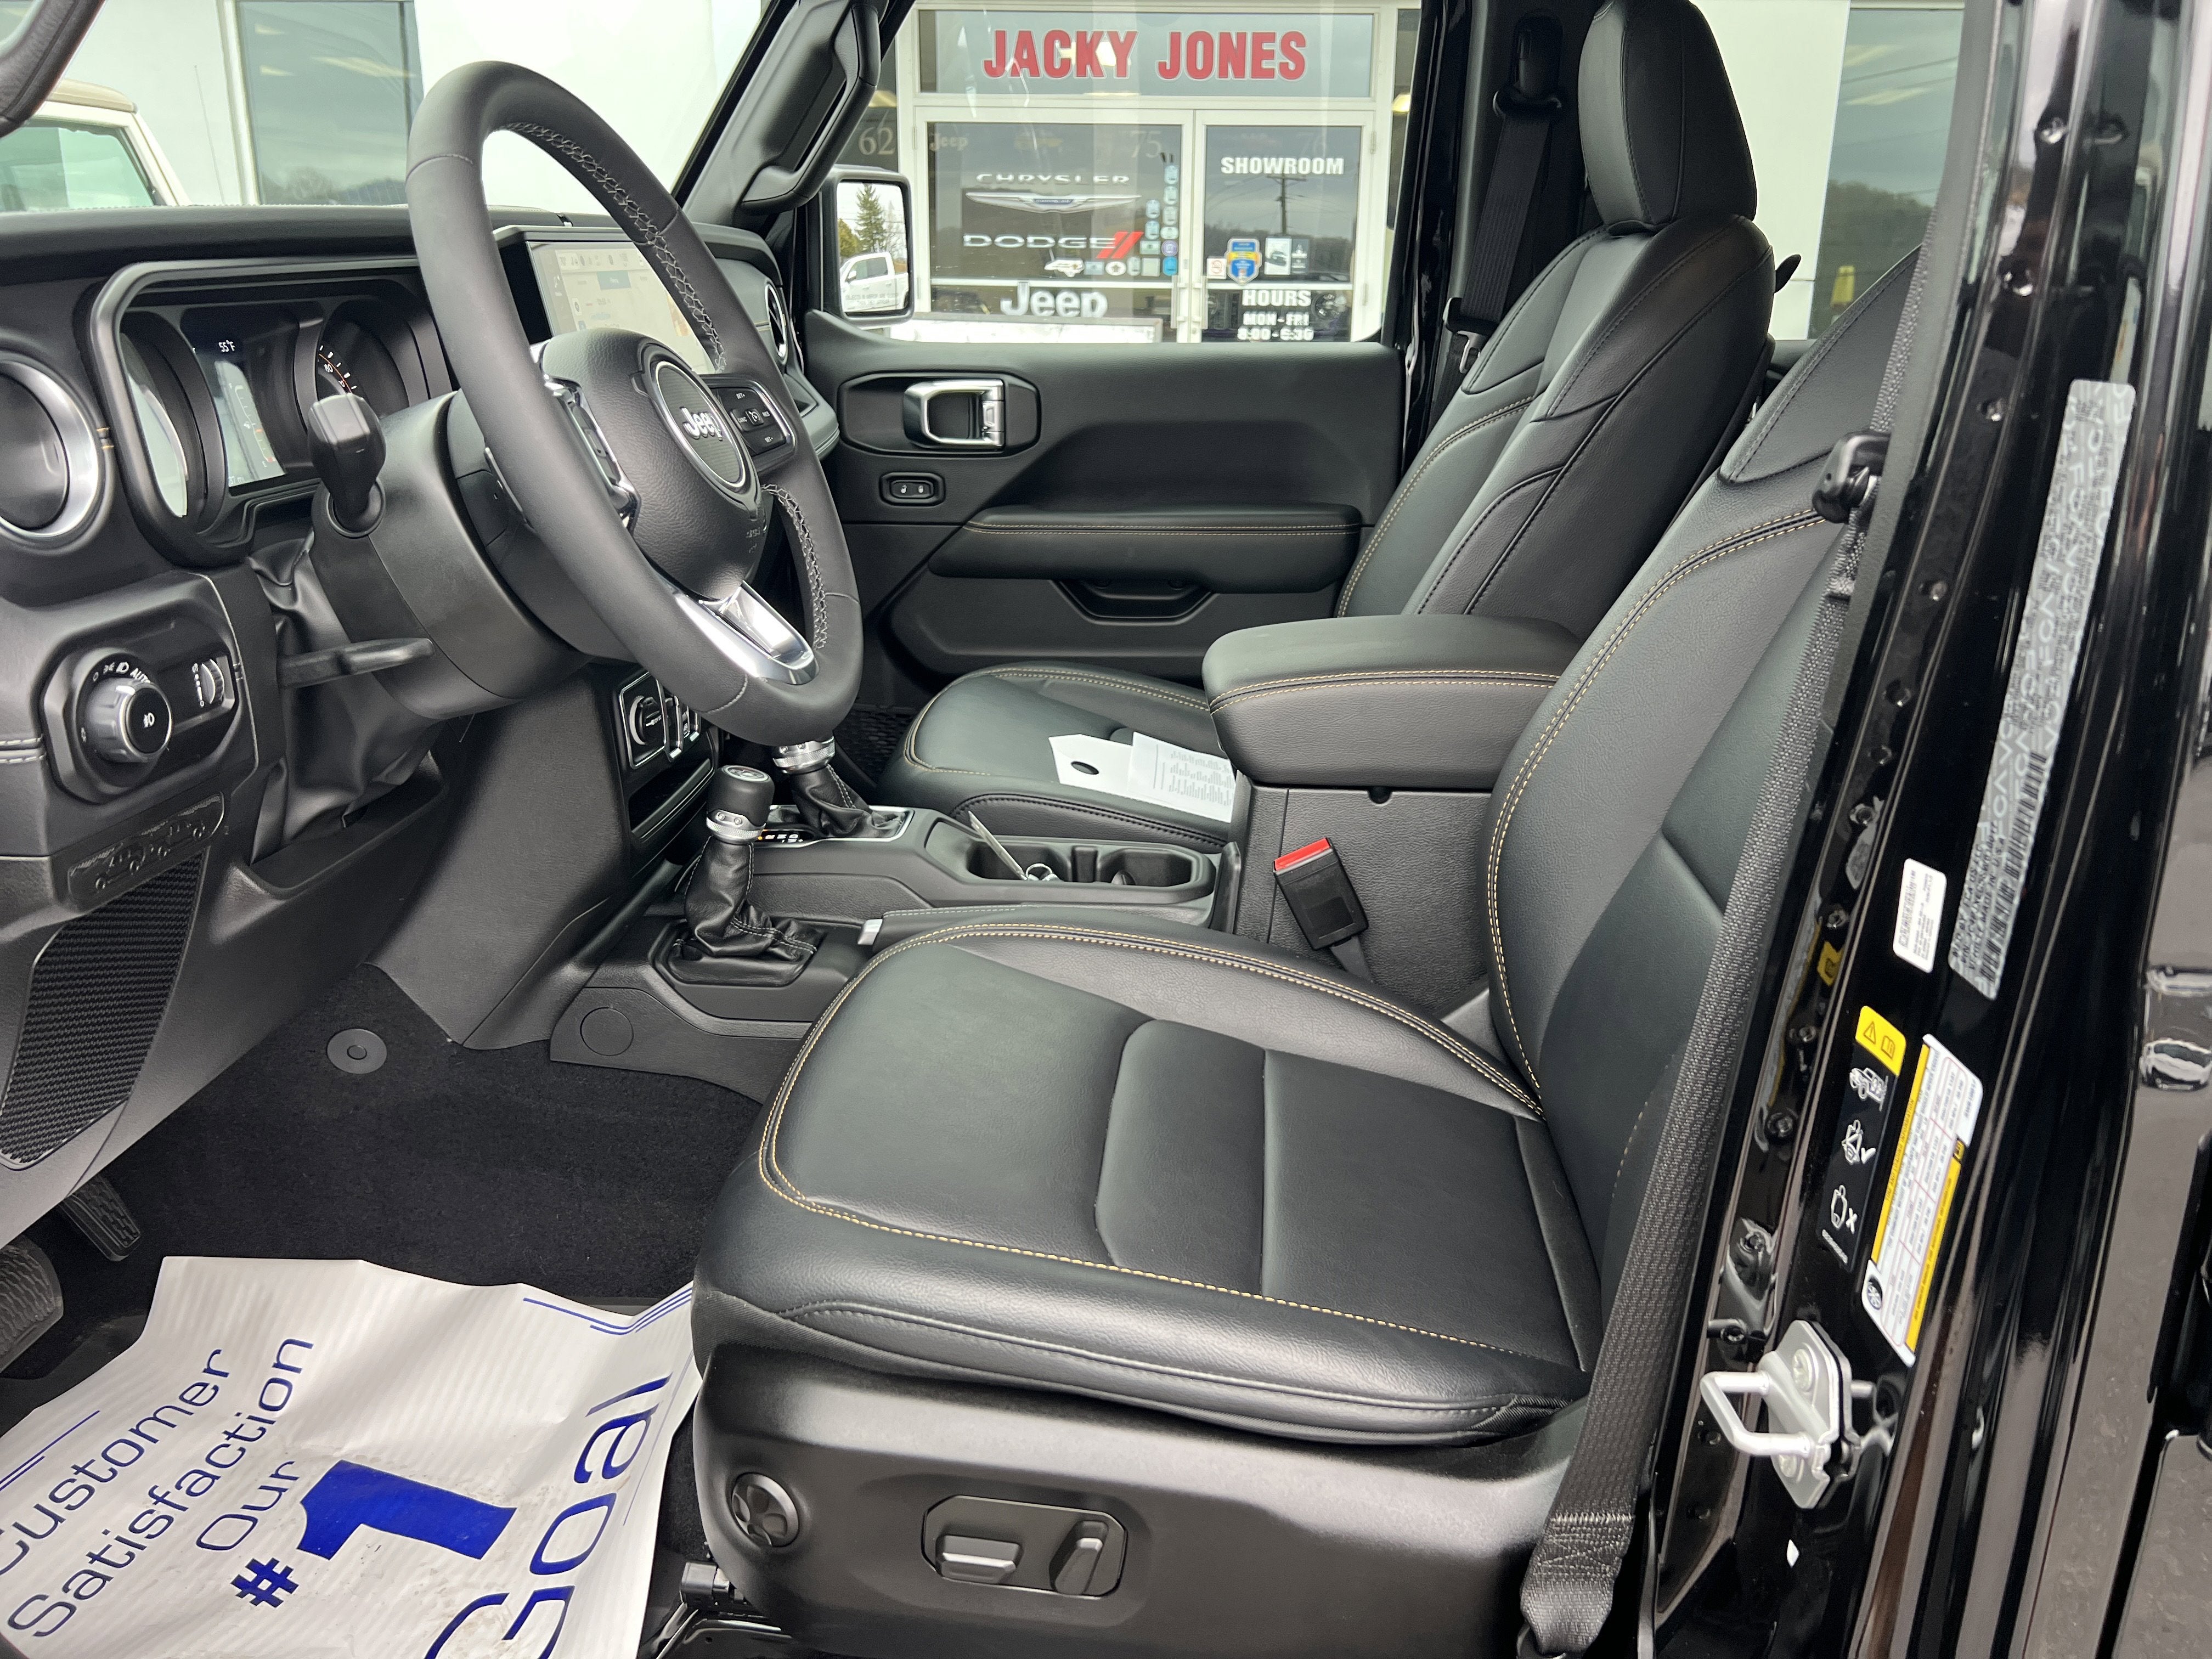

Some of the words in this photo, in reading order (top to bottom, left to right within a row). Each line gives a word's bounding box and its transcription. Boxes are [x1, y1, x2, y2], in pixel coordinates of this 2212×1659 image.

[984, 31, 1137, 78] JACKY
[1158, 31, 1307, 80] JONES
[859, 126, 895, 156] 62
[976, 173, 1130, 184] CHRYSLER
[1220, 157, 1345, 175] SHOWROOM
[963, 233, 1116, 249] DODGE
[1000, 281, 1108, 318] Jeep
[1242, 290, 1311, 306] HOURS
[680, 407, 723, 441] Jeep
[7, 1337, 314, 1637] Satisfaction
[195, 1459, 302, 1551] Our
[424, 1373, 672, 1659] Goal
